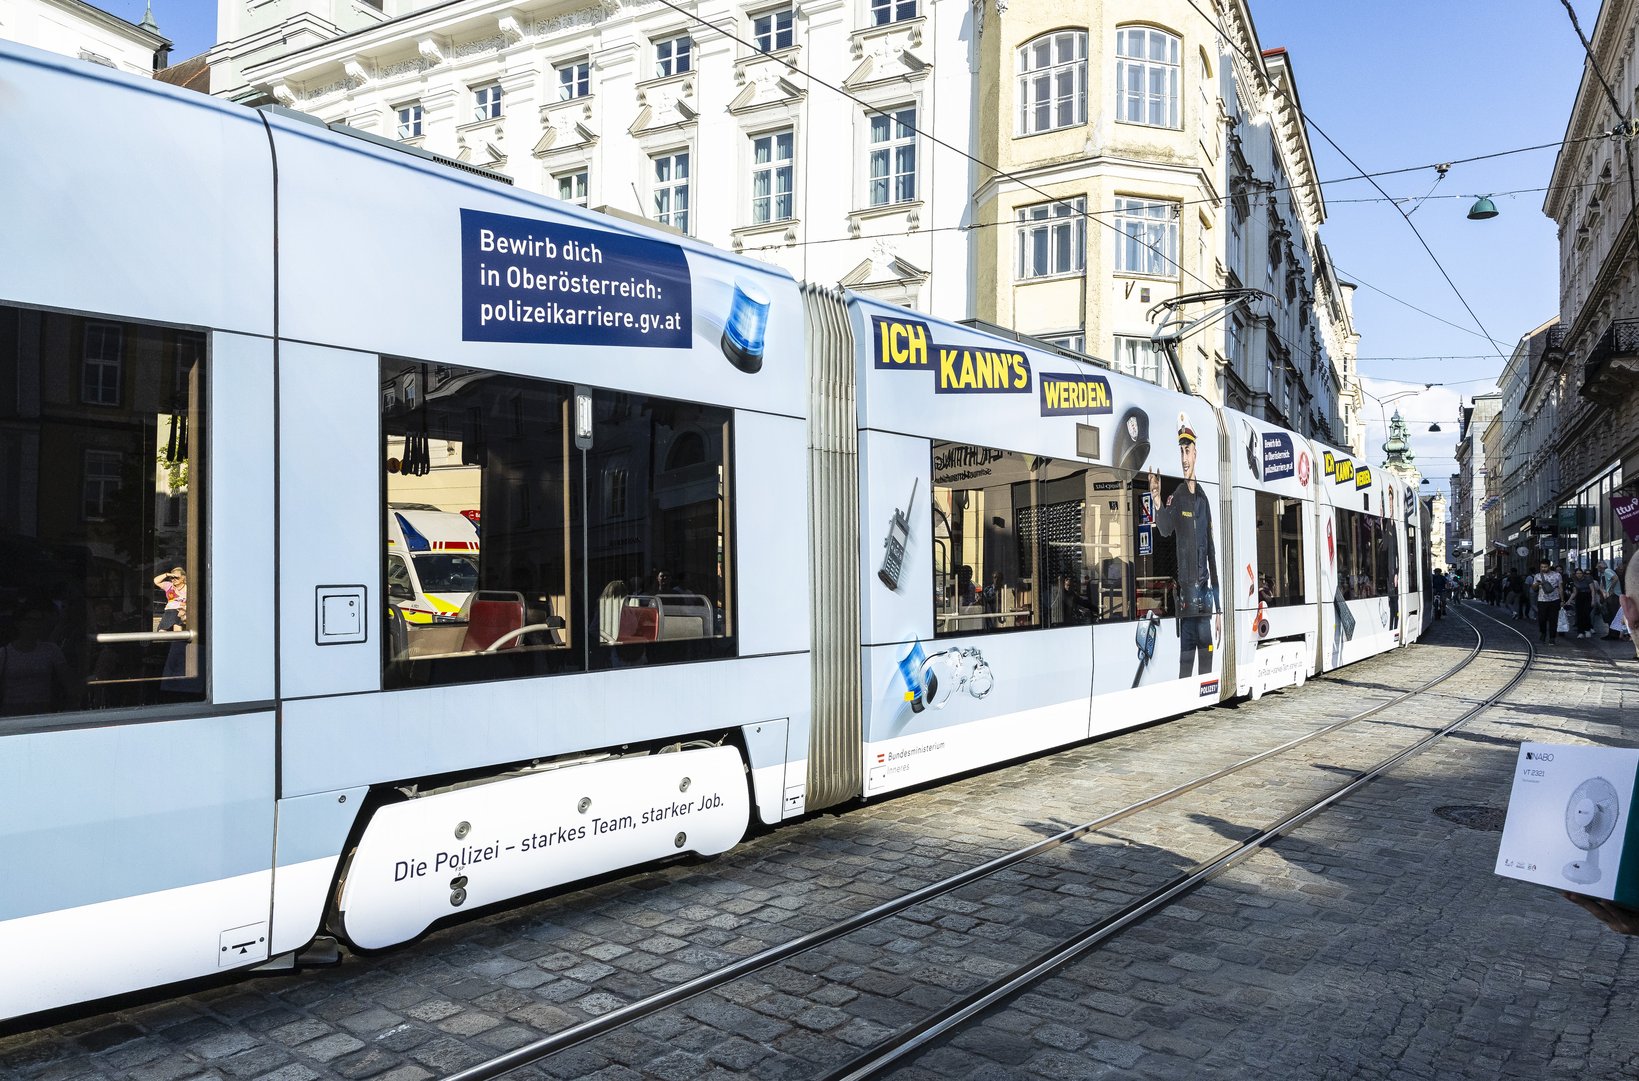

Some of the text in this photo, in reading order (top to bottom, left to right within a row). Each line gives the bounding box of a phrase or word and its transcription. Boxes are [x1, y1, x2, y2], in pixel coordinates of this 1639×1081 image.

[480, 229, 603, 264] Bewirb dich
[480, 264, 662, 299] in Oberösterreich:
[480, 299, 681, 333] polizeikarriere.gv.at
[880, 321, 928, 364] ICH
[940, 350, 1027, 389] KANN'S
[1044, 381, 1110, 409] WERDEN.
[888, 742, 945, 761] Bundesministerium
[1531, 752, 1554, 762] NABO
[887, 764, 910, 774] Inneres
[394, 859, 427, 882] Die
[435, 840, 499, 873] Polizei
[521, 825, 586, 853] starkes
[592, 813, 637, 837] Team,
[641, 800, 694, 825] starker
[697, 791, 725, 812] Job.
